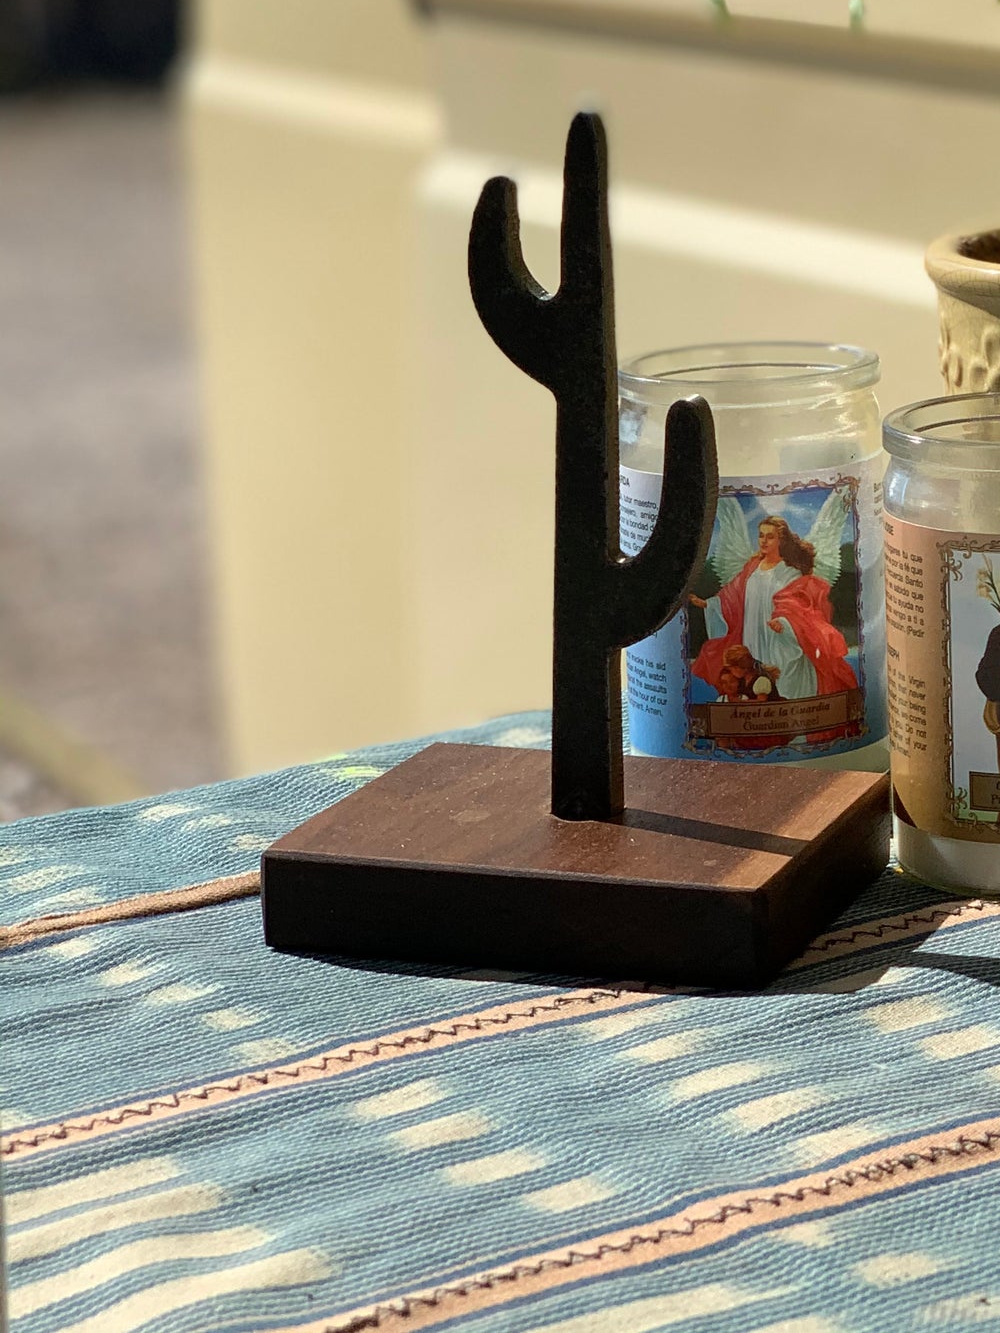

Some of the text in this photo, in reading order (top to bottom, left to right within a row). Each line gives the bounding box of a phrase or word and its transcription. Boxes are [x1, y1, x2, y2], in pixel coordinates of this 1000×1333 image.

[910, 553, 923, 563] que
[911, 566, 923, 576] que
[905, 575, 923, 588] Santo
[911, 591, 924, 601] que
[915, 606, 924, 614] no
[648, 672, 667, 683] watch
[908, 675, 926, 689] Virgin
[908, 689, 926, 701] never
[656, 698, 667, 706] our
[764, 709, 775, 717] de
[779, 707, 788, 716] la
[791, 701, 831, 716] Guardia
[909, 701, 927, 716] being
[743, 716, 819, 731] Guardian Angel
[909, 715, 927, 726] come
